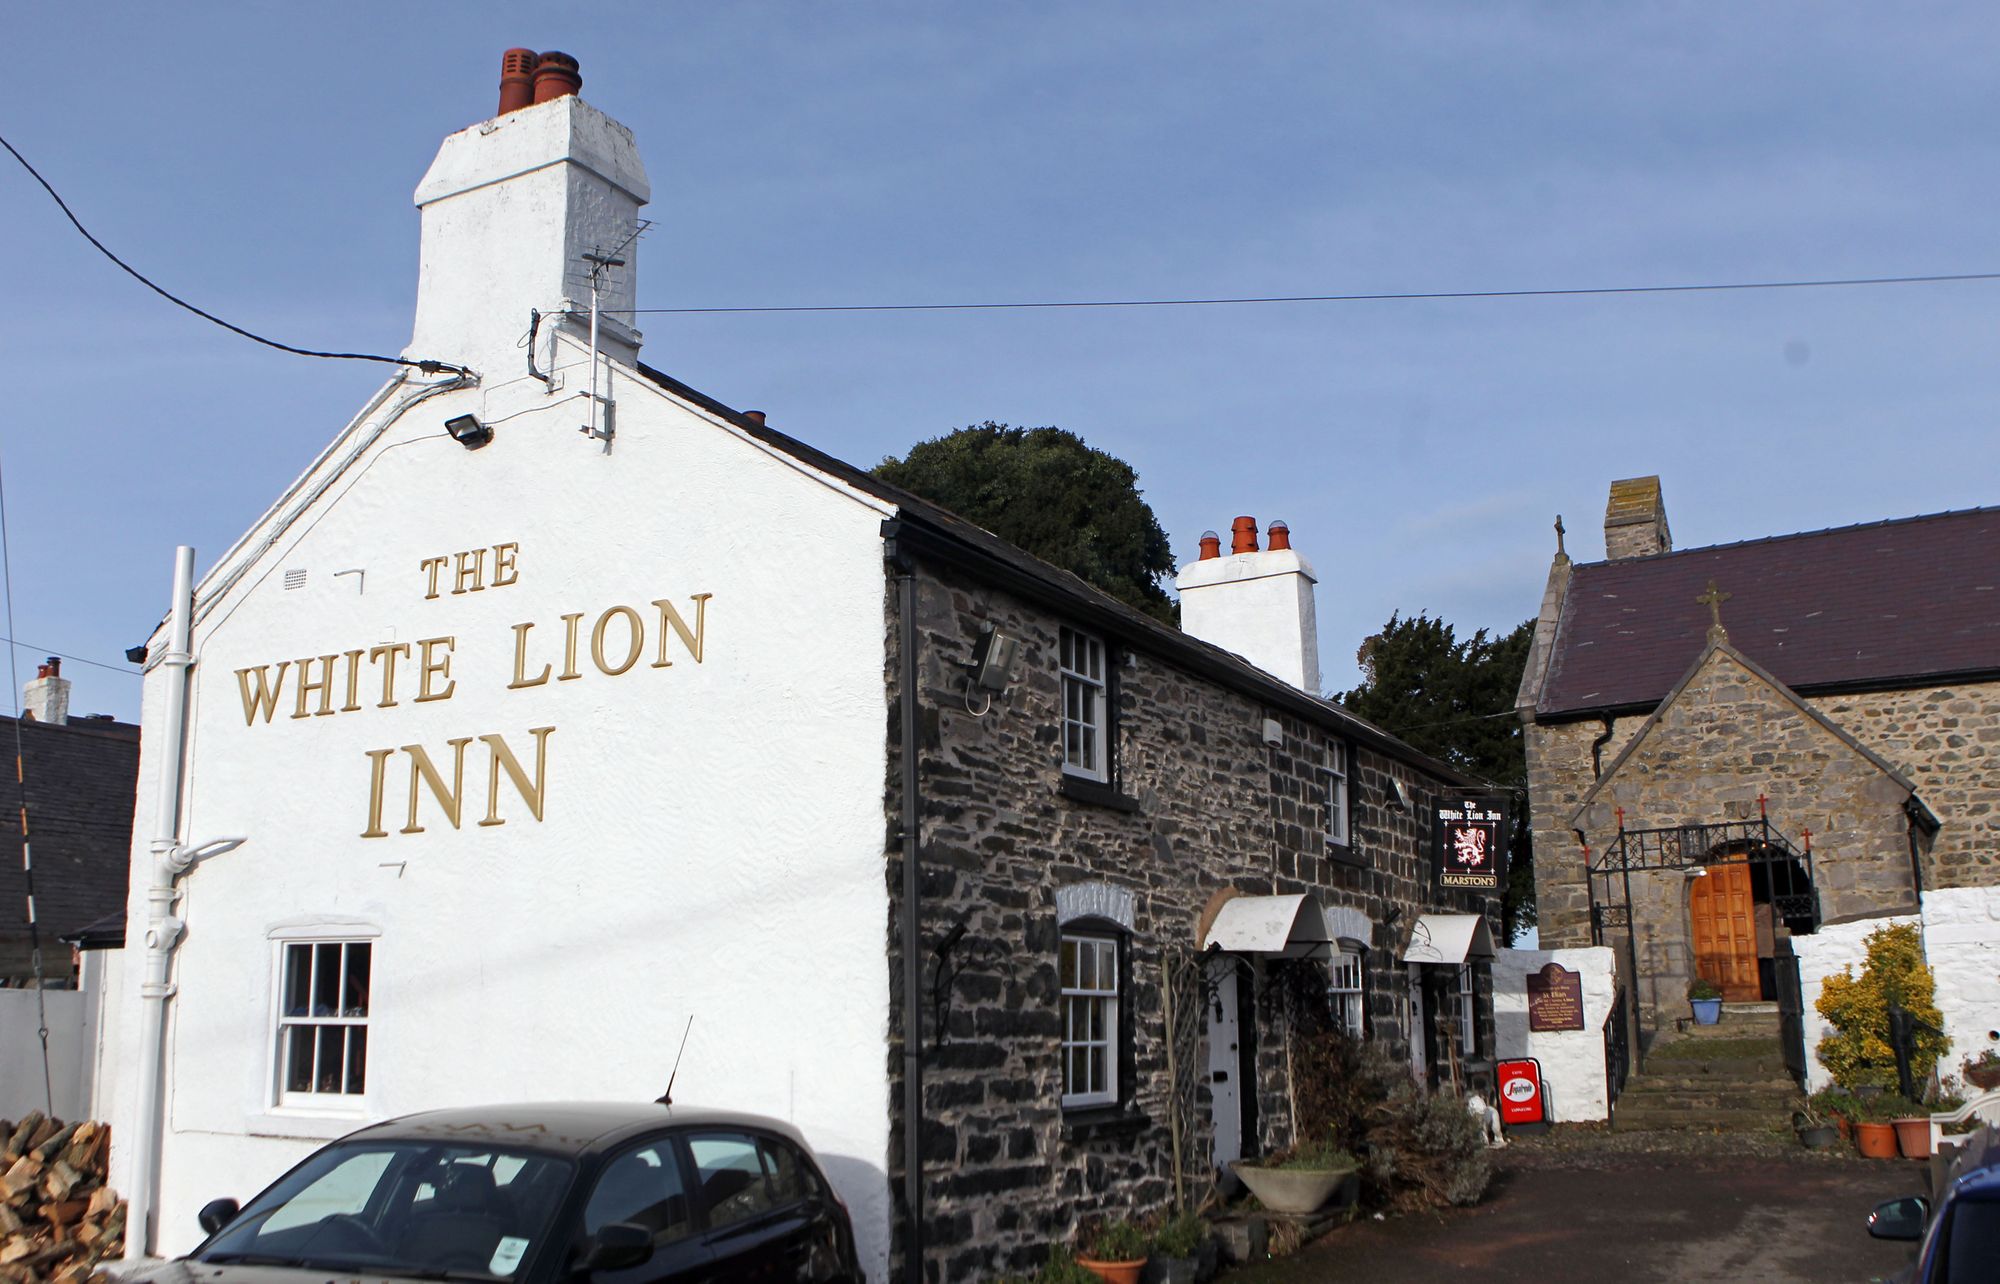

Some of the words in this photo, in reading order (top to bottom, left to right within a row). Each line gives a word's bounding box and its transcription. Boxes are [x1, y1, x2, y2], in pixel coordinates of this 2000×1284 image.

[419, 541, 520, 600] THE
[233, 635, 456, 727] WHITE
[506, 592, 713, 690] LION
[359, 725, 556, 839] INN
[1439, 810, 1463, 820] White
[1466, 810, 1484, 820] Lion
[1487, 810, 1501, 820] Inn
[1464, 801, 1476, 809] The
[1444, 876, 1494, 886] MARSTON'S
